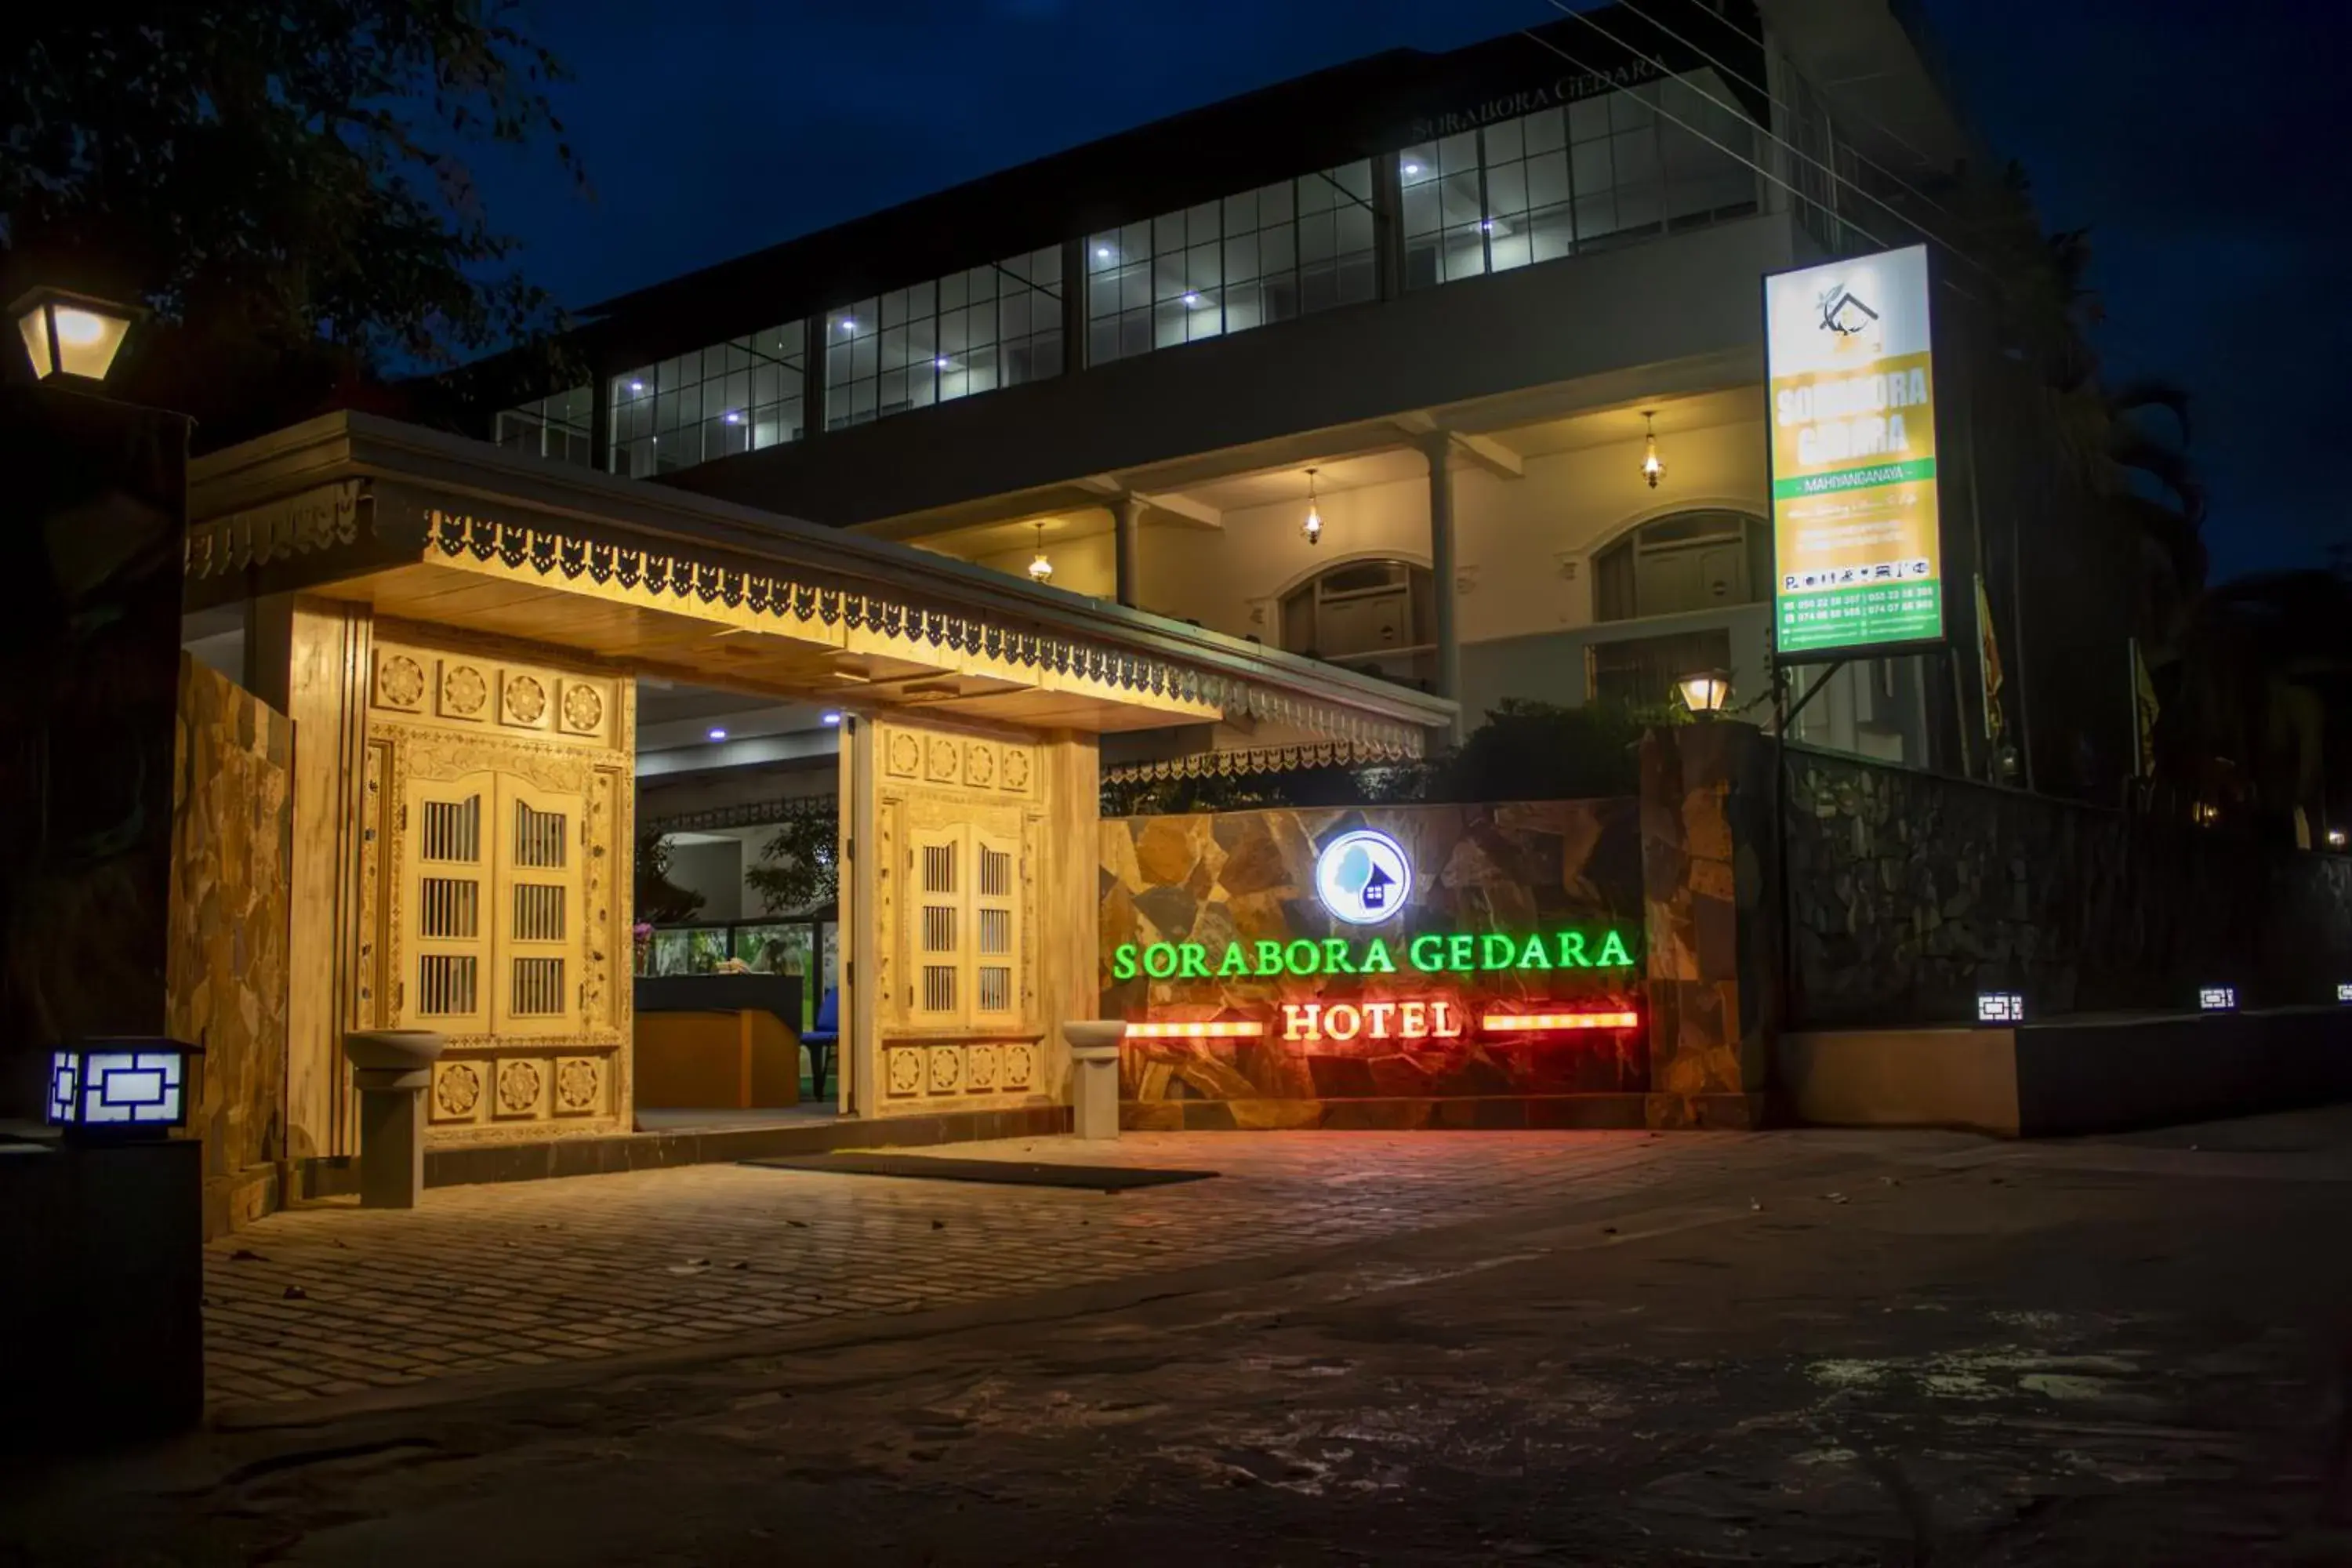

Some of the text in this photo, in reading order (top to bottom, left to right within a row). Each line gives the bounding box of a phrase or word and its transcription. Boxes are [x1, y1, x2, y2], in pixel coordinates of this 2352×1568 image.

[1555, 52, 1668, 103] GEDARA
[1113, 931, 1634, 979] SORABORA GEDARA
[1282, 1000, 1462, 1041] HOTEL
